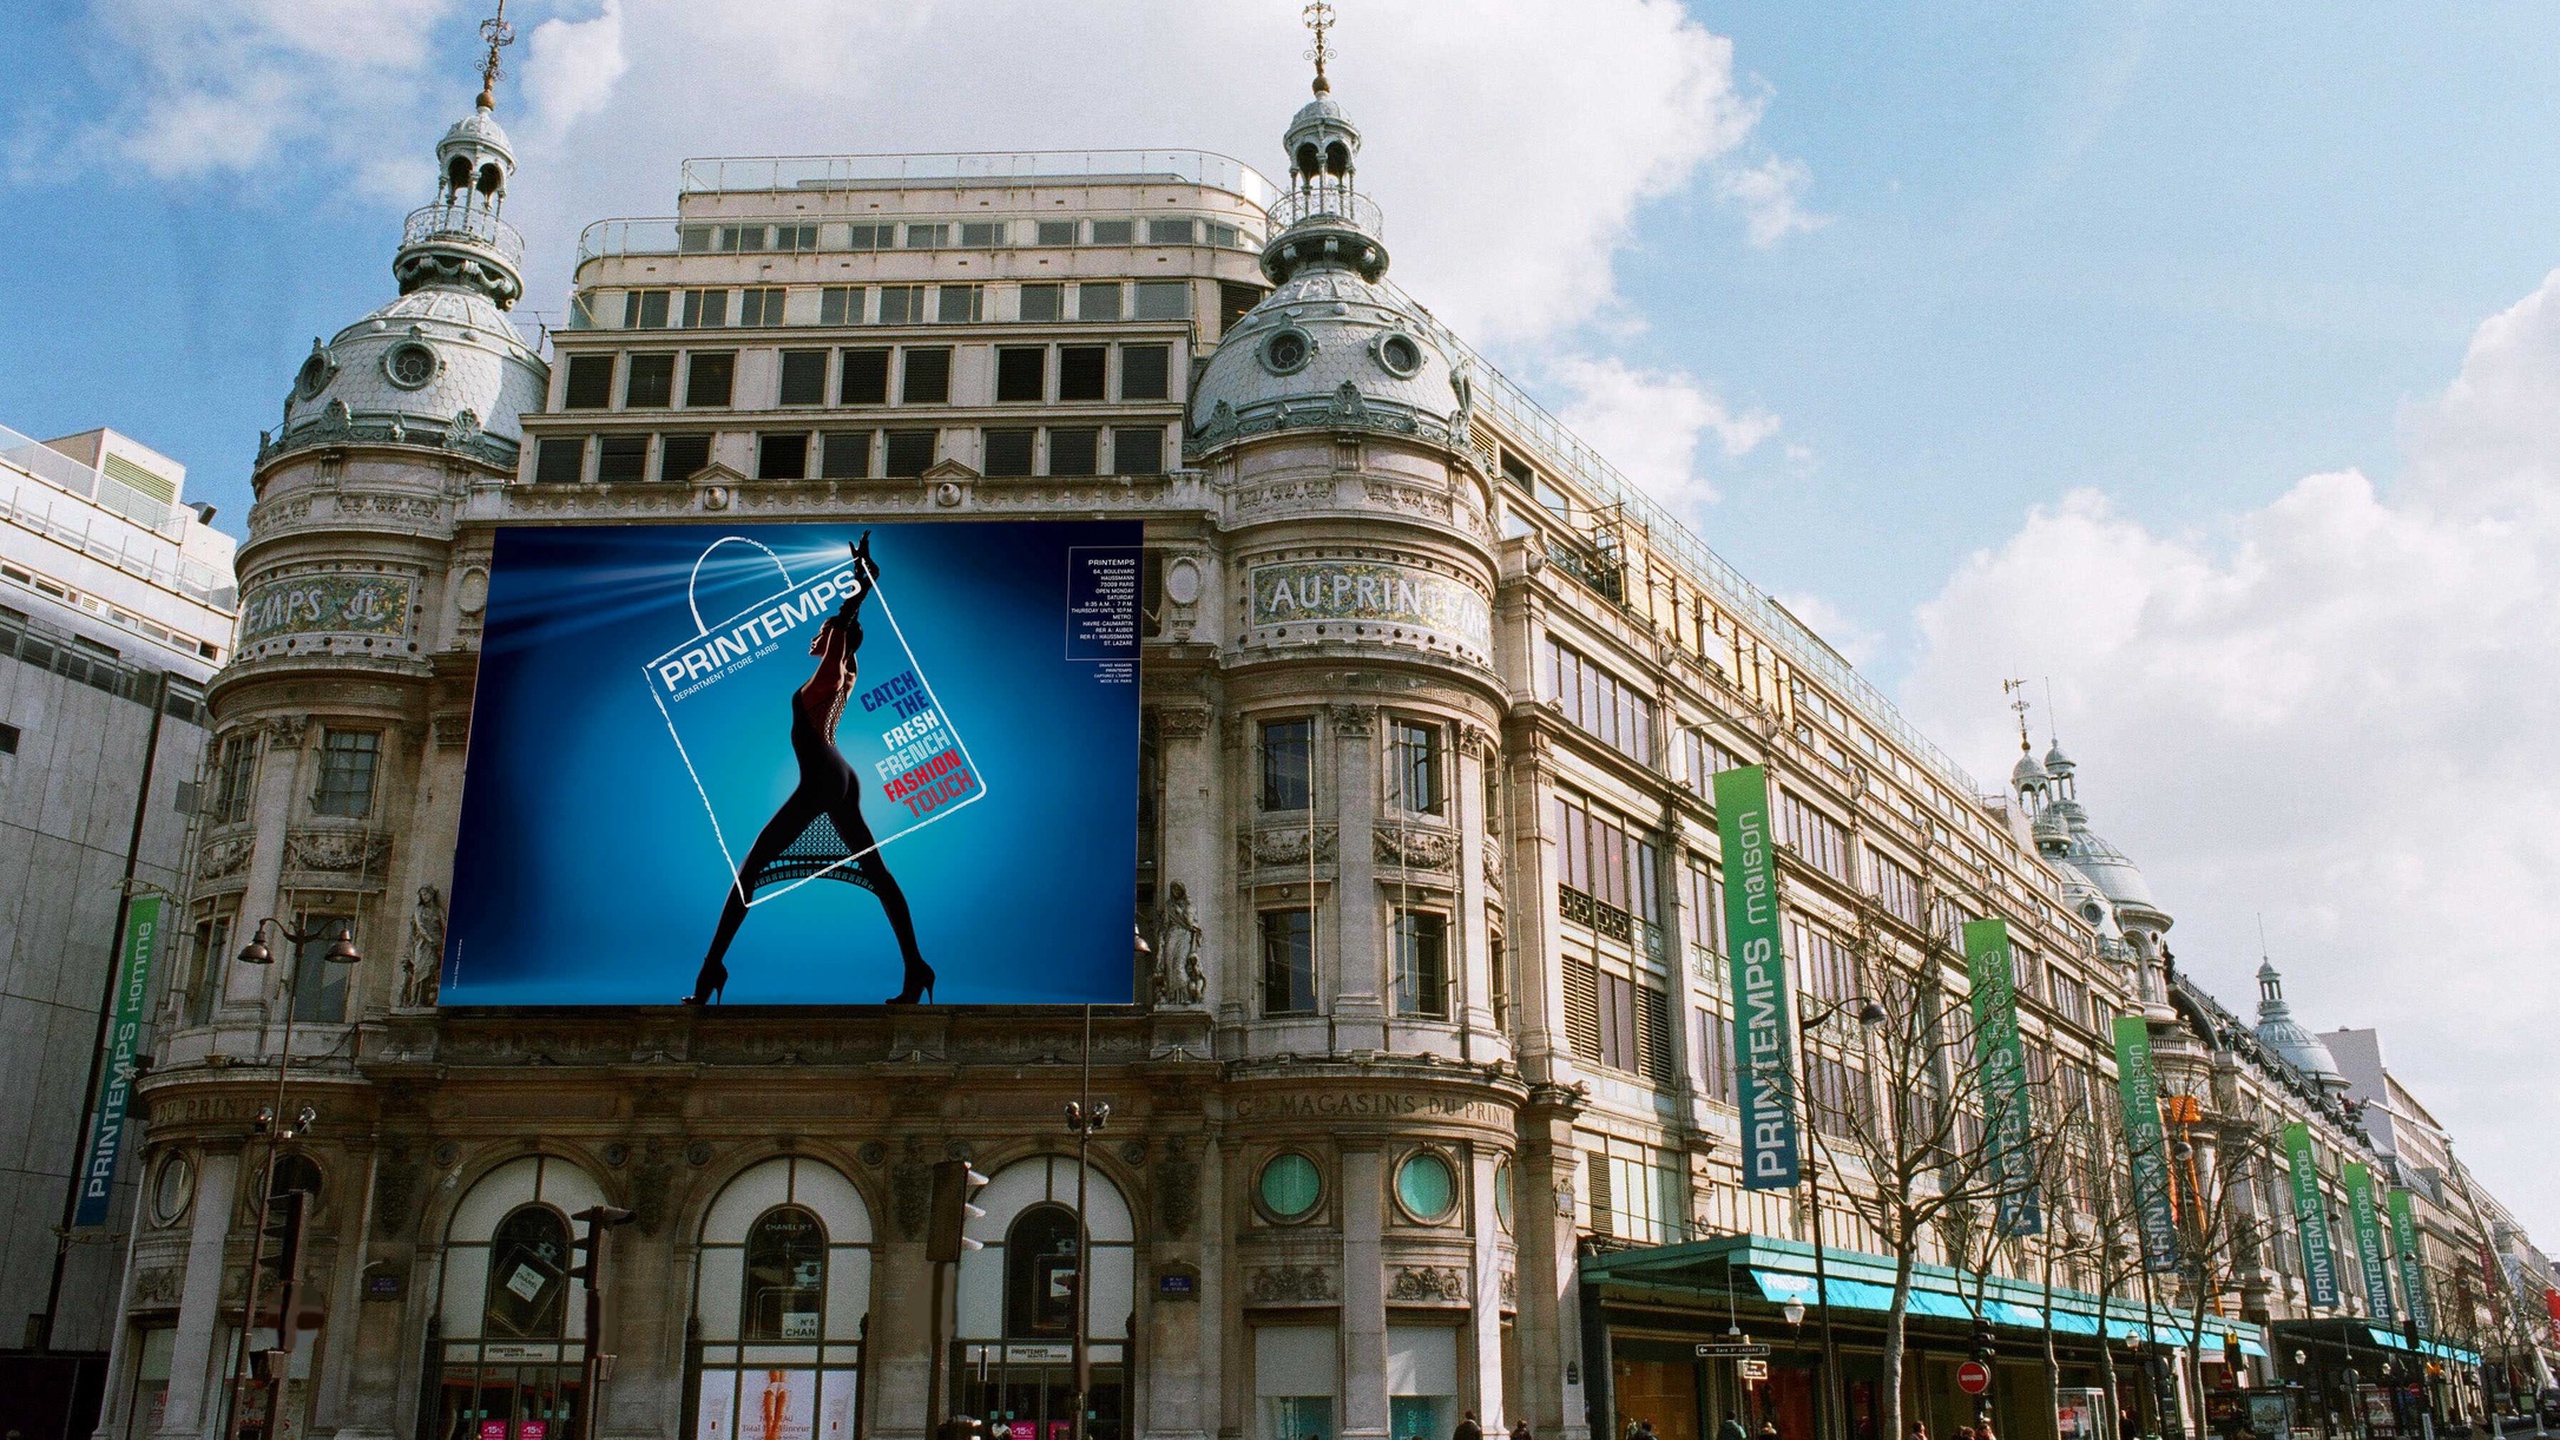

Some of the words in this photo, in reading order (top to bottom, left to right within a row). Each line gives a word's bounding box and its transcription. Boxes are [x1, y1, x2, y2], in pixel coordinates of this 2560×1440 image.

[1270, 575, 1320, 612] AU
[659, 570, 861, 692] PRINTEMPS
[673, 670, 726, 702] DEPARTMENT
[727, 656, 754, 674] STORE
[754, 642, 779, 660] PARIS
[860, 670, 919, 713] CATCH
[882, 708, 941, 751] FRESH
[892, 689, 930, 719] THE
[874, 728, 951, 781] FRENCH
[883, 748, 962, 803] FASHION
[903, 768, 975, 818] TOUCH
[1738, 810, 1769, 925] maison
[1743, 936, 1788, 1177] PRINTEMPS
[88, 1021, 136, 1198] PRINTEMPS
[1281, 1094, 1416, 1115] MAGASINS
[1428, 1098, 1459, 1116] DU
[2296, 1150, 2314, 1194] mode
[2355, 1187, 2373, 1224] mode
[2302, 1198, 2333, 1302] PRINTEMPS
[2361, 1228, 2389, 1318] PRINTEMPS
